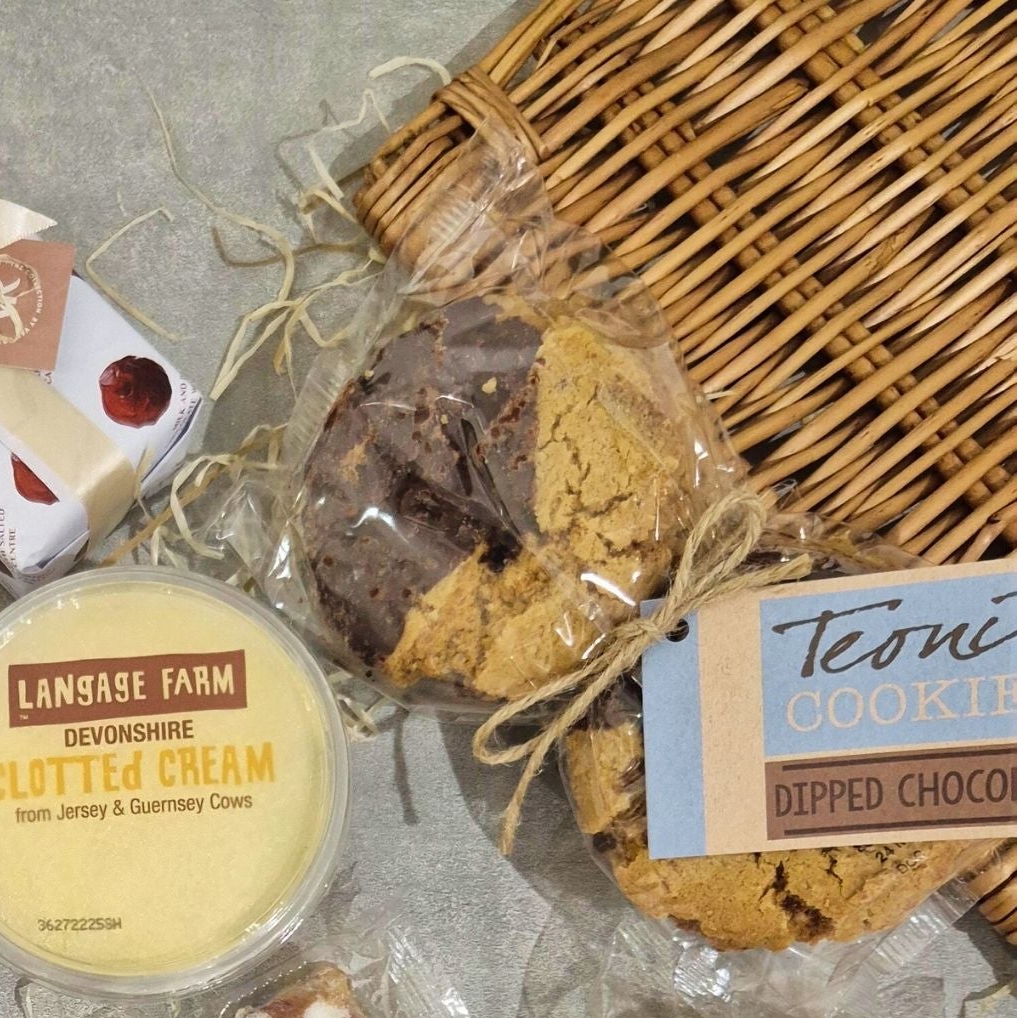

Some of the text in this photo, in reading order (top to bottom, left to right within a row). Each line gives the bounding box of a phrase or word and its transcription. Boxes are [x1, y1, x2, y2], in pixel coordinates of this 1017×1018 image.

[772, 591, 1017, 678] Teoni
[161, 663, 236, 700] FARM
[64, 719, 195, 748] DEVONSHIRE
[158, 741, 276, 789] CREAM
[15, 792, 253, 824] from Jersey & Guernsey Cows
[775, 777, 883, 818] DIPPED
